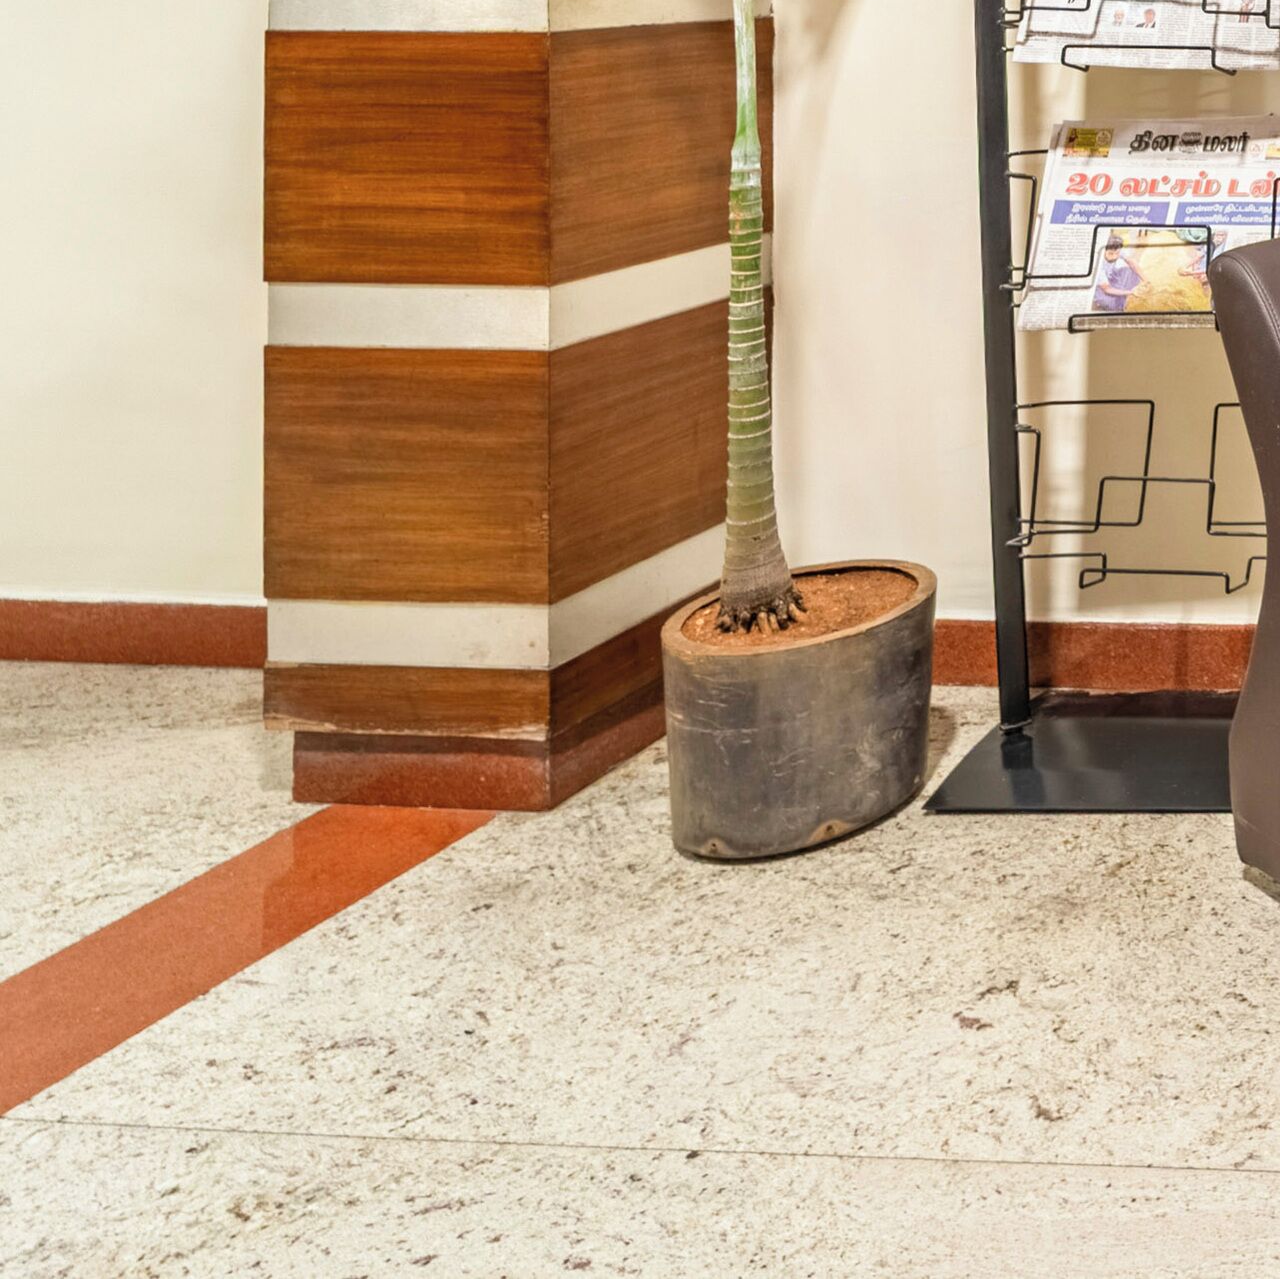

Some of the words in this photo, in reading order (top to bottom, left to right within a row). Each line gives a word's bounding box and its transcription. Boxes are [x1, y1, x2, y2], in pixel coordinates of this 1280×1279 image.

[1128, 130, 1179, 155] தின
[1202, 132, 1250, 152] மலர்
[1066, 172, 1113, 196] 20
[1120, 170, 1221, 197] லட்சம்
